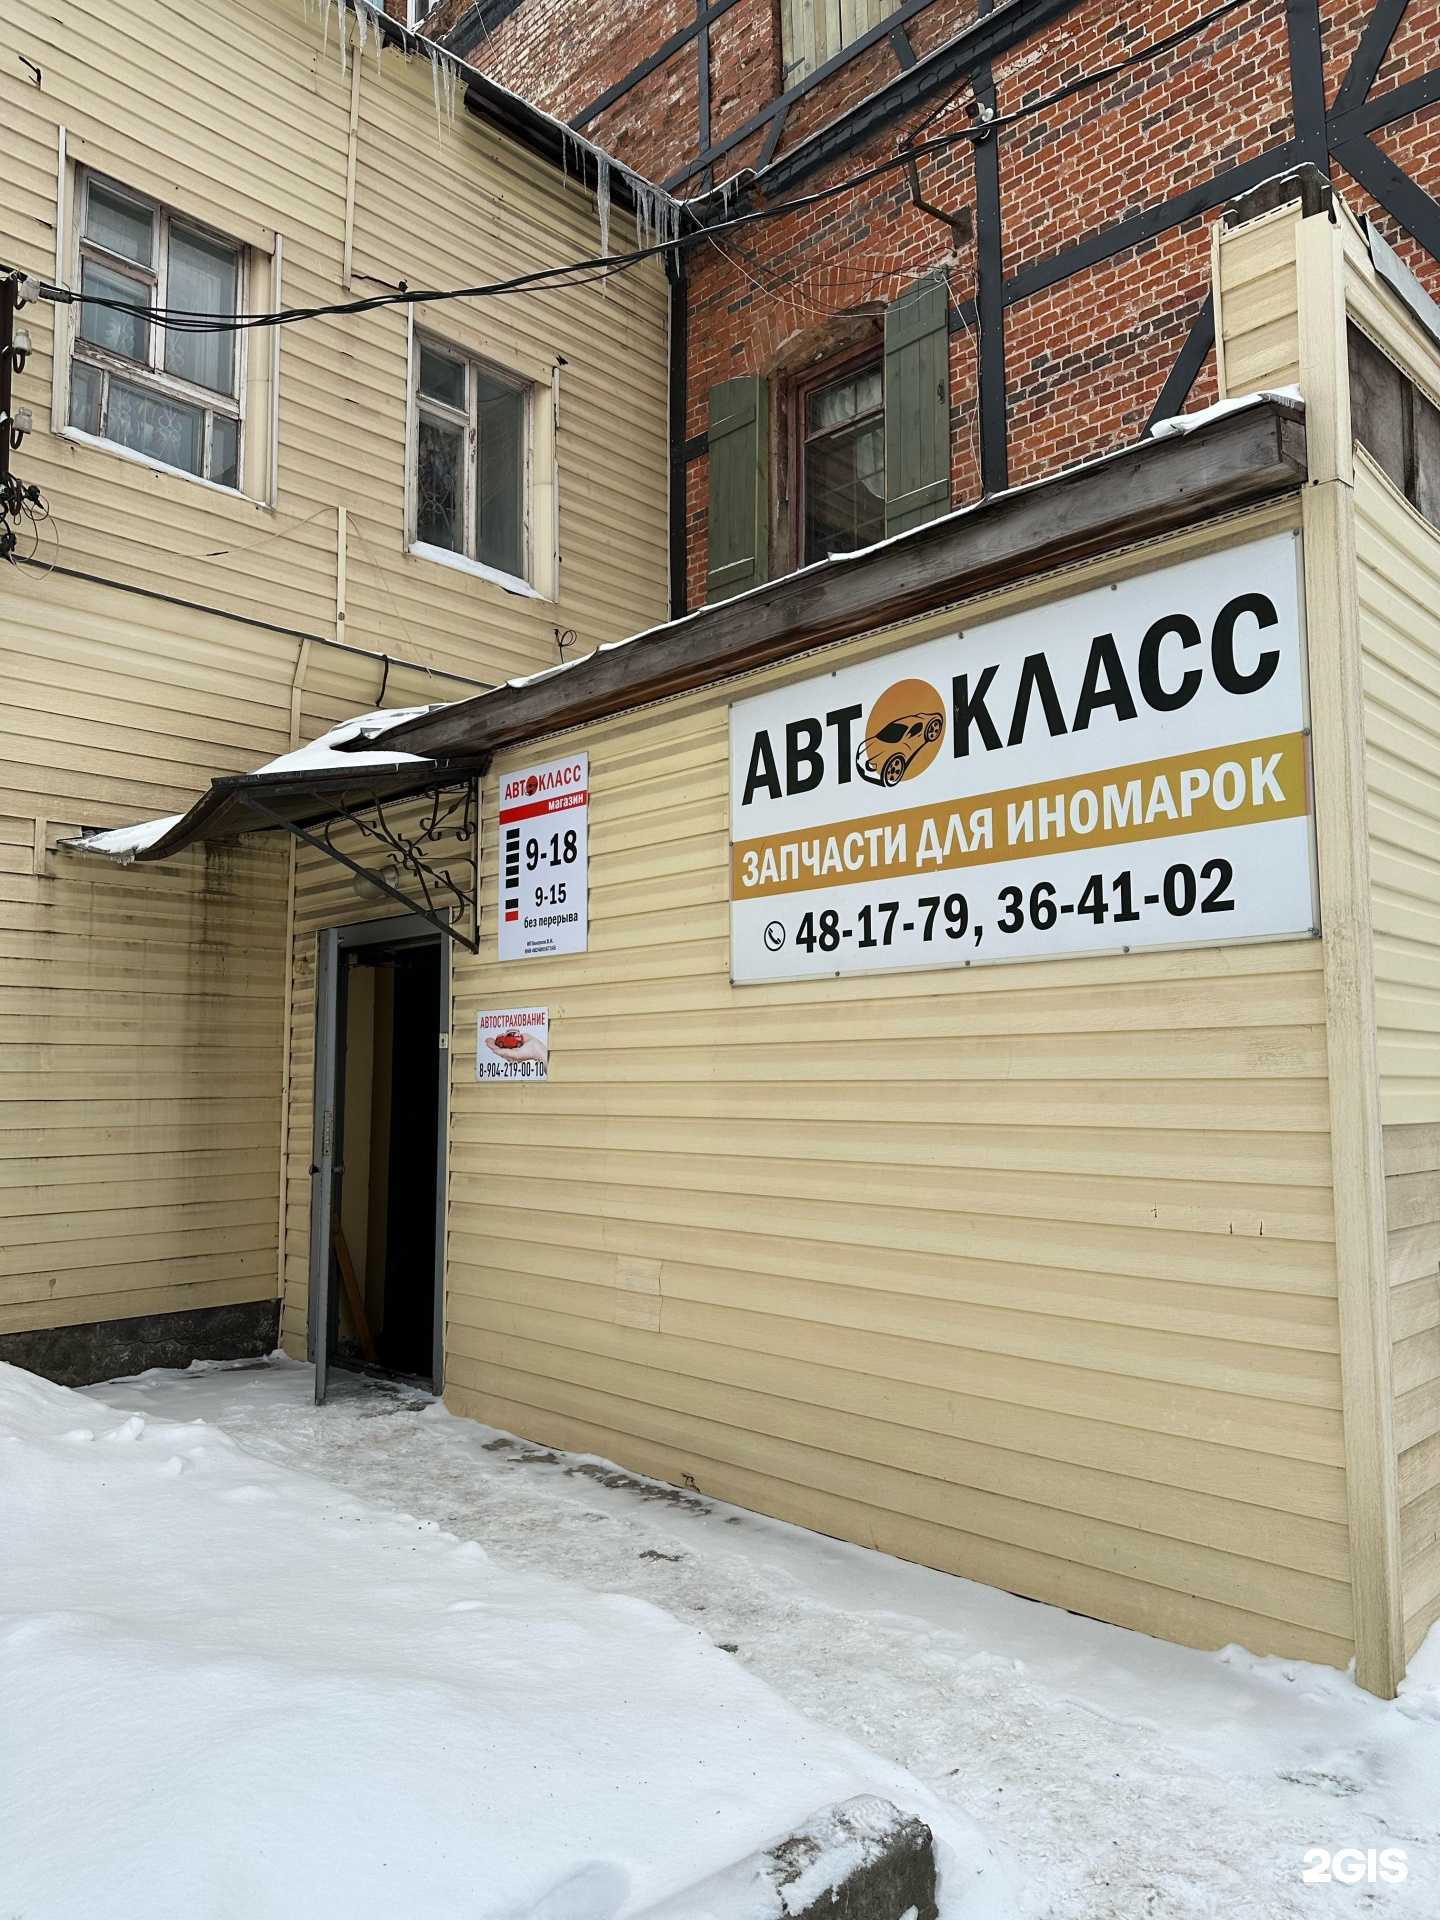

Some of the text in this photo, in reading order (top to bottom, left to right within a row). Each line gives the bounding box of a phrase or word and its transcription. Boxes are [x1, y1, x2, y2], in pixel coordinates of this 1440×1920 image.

[548, 793, 584, 811] магазин
[741, 752, 1286, 887] ЗАПЧАСТИ ДЛЯ ИНОМАРОК
[526, 829, 578, 871] 9-18
[535, 882, 567, 907] 9-15
[795, 857, 1235, 954] 48-17-79, 36-41-02
[523, 912, 578, 929] без перерыва
[480, 1012, 546, 1029] АВТОСТРАХОВАНИЕ
[479, 1061, 544, 1078] 8-904-219-00-10
